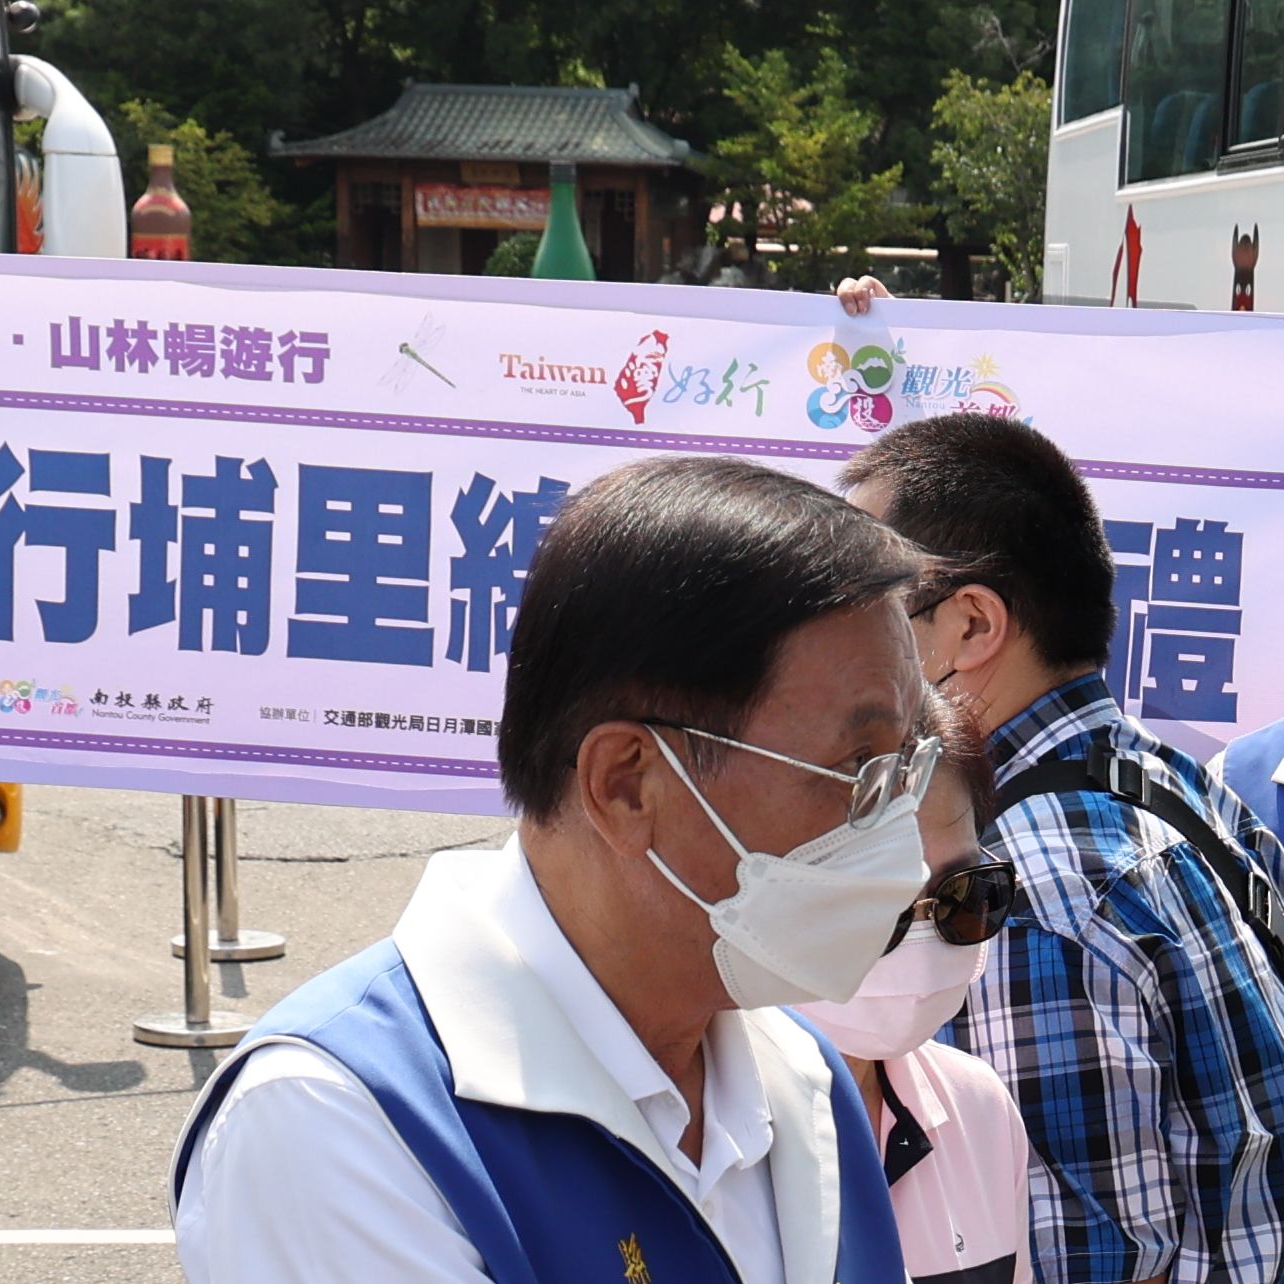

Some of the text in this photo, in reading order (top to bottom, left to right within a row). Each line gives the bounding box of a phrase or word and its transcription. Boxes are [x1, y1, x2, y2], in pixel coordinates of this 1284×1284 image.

[499, 352, 607, 385] Taiwan
[901, 364, 973, 398] 觀光
[1102, 517, 1244, 723] 禮
[89, 688, 215, 715] 南投縣政府
[92, 708, 124, 720] Nantou
[126, 711, 156, 723] County
